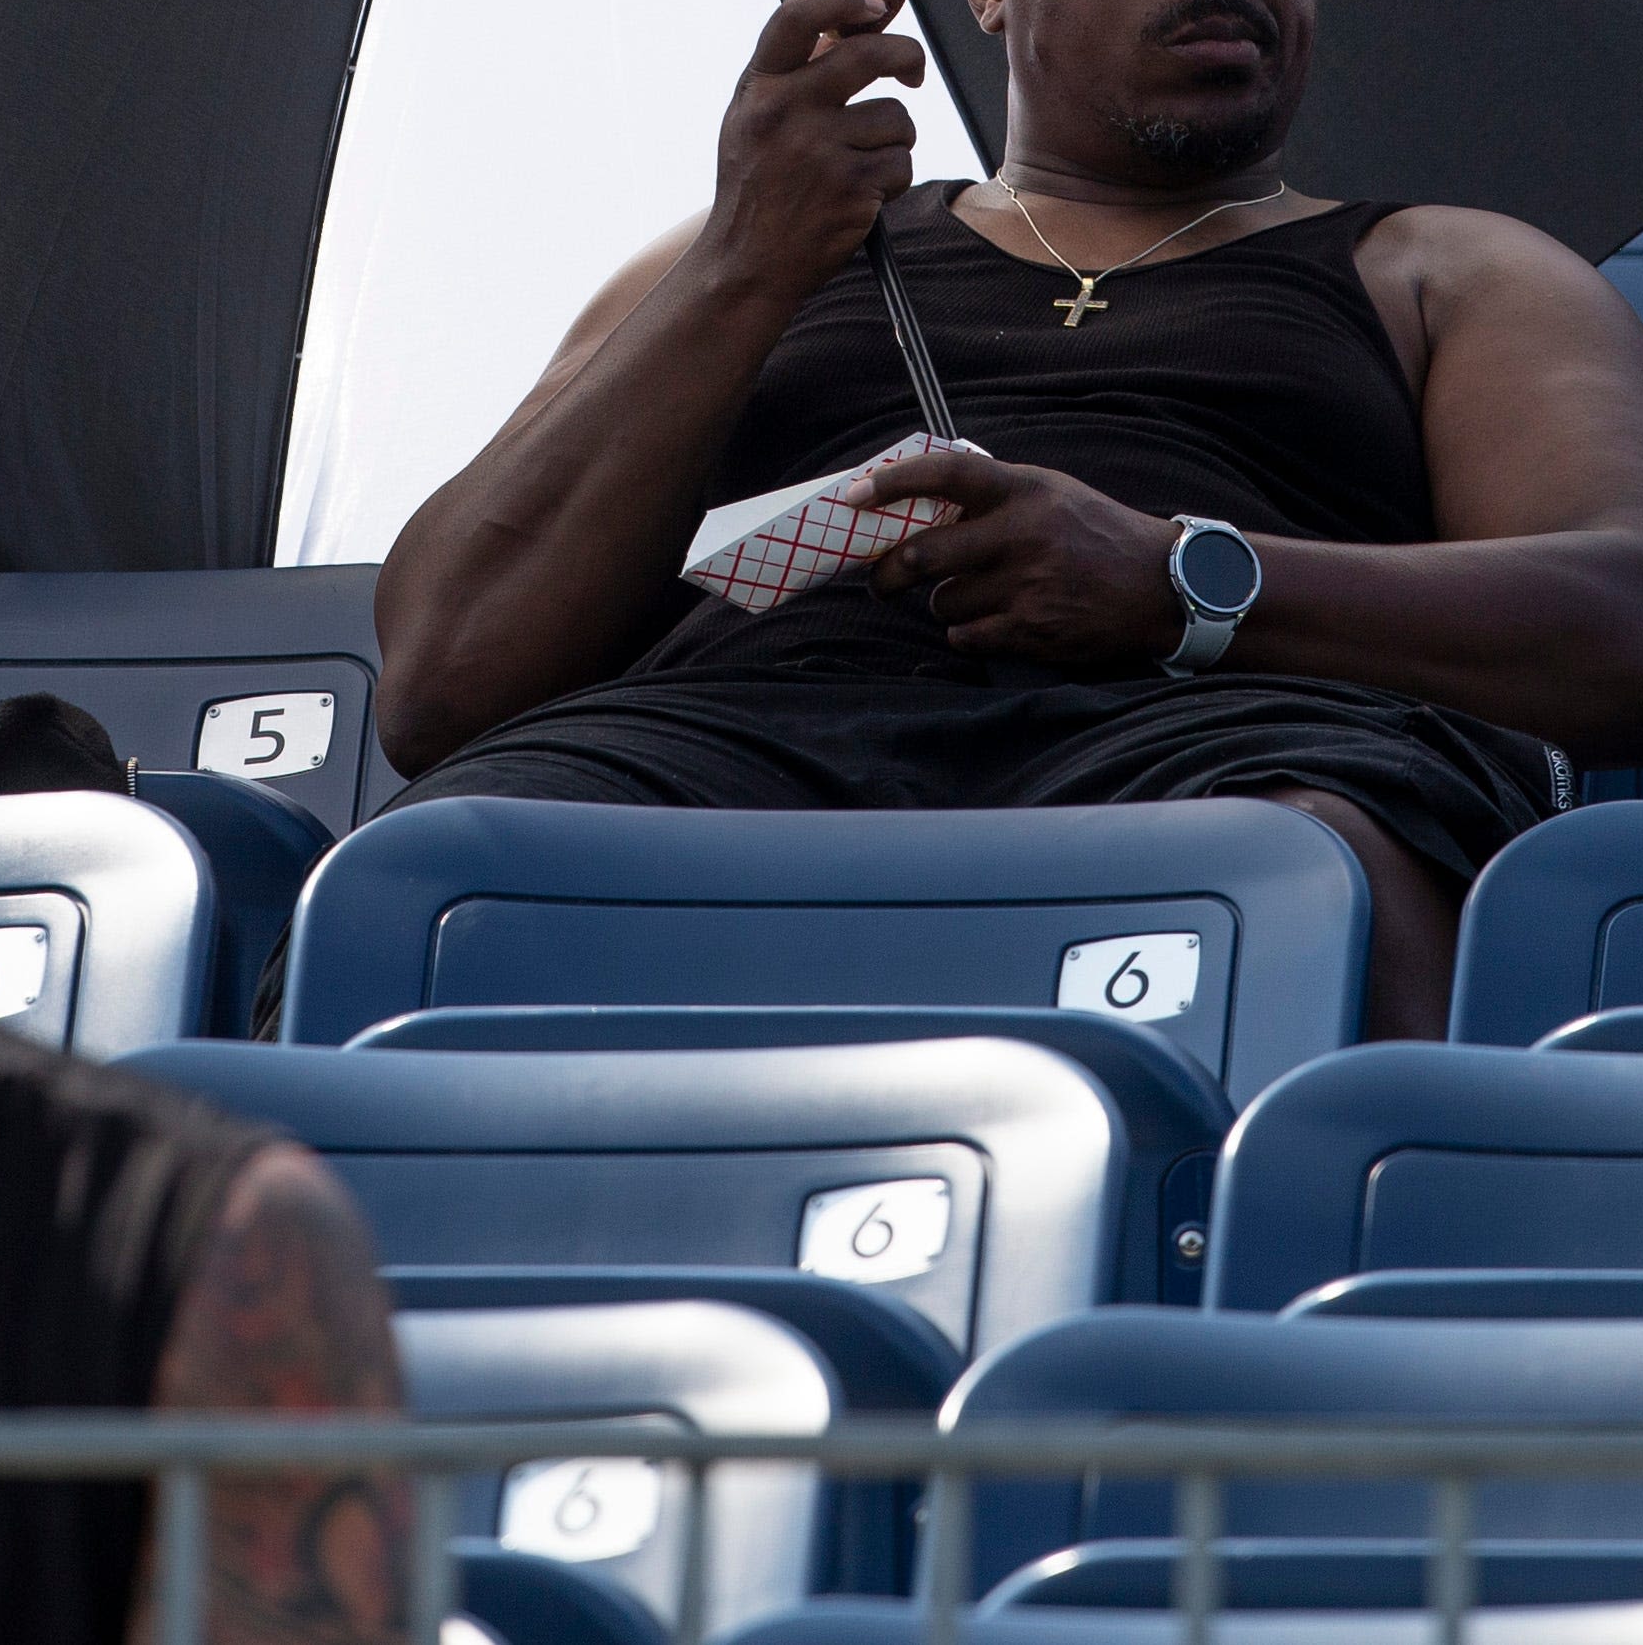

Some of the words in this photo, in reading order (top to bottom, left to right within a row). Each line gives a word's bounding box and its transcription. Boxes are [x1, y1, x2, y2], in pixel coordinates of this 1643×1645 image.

[244, 708, 285, 765] 5
[1105, 951, 1149, 1008] 6
[852, 1201, 893, 1258] 6
[554, 1464, 602, 1536] 6
